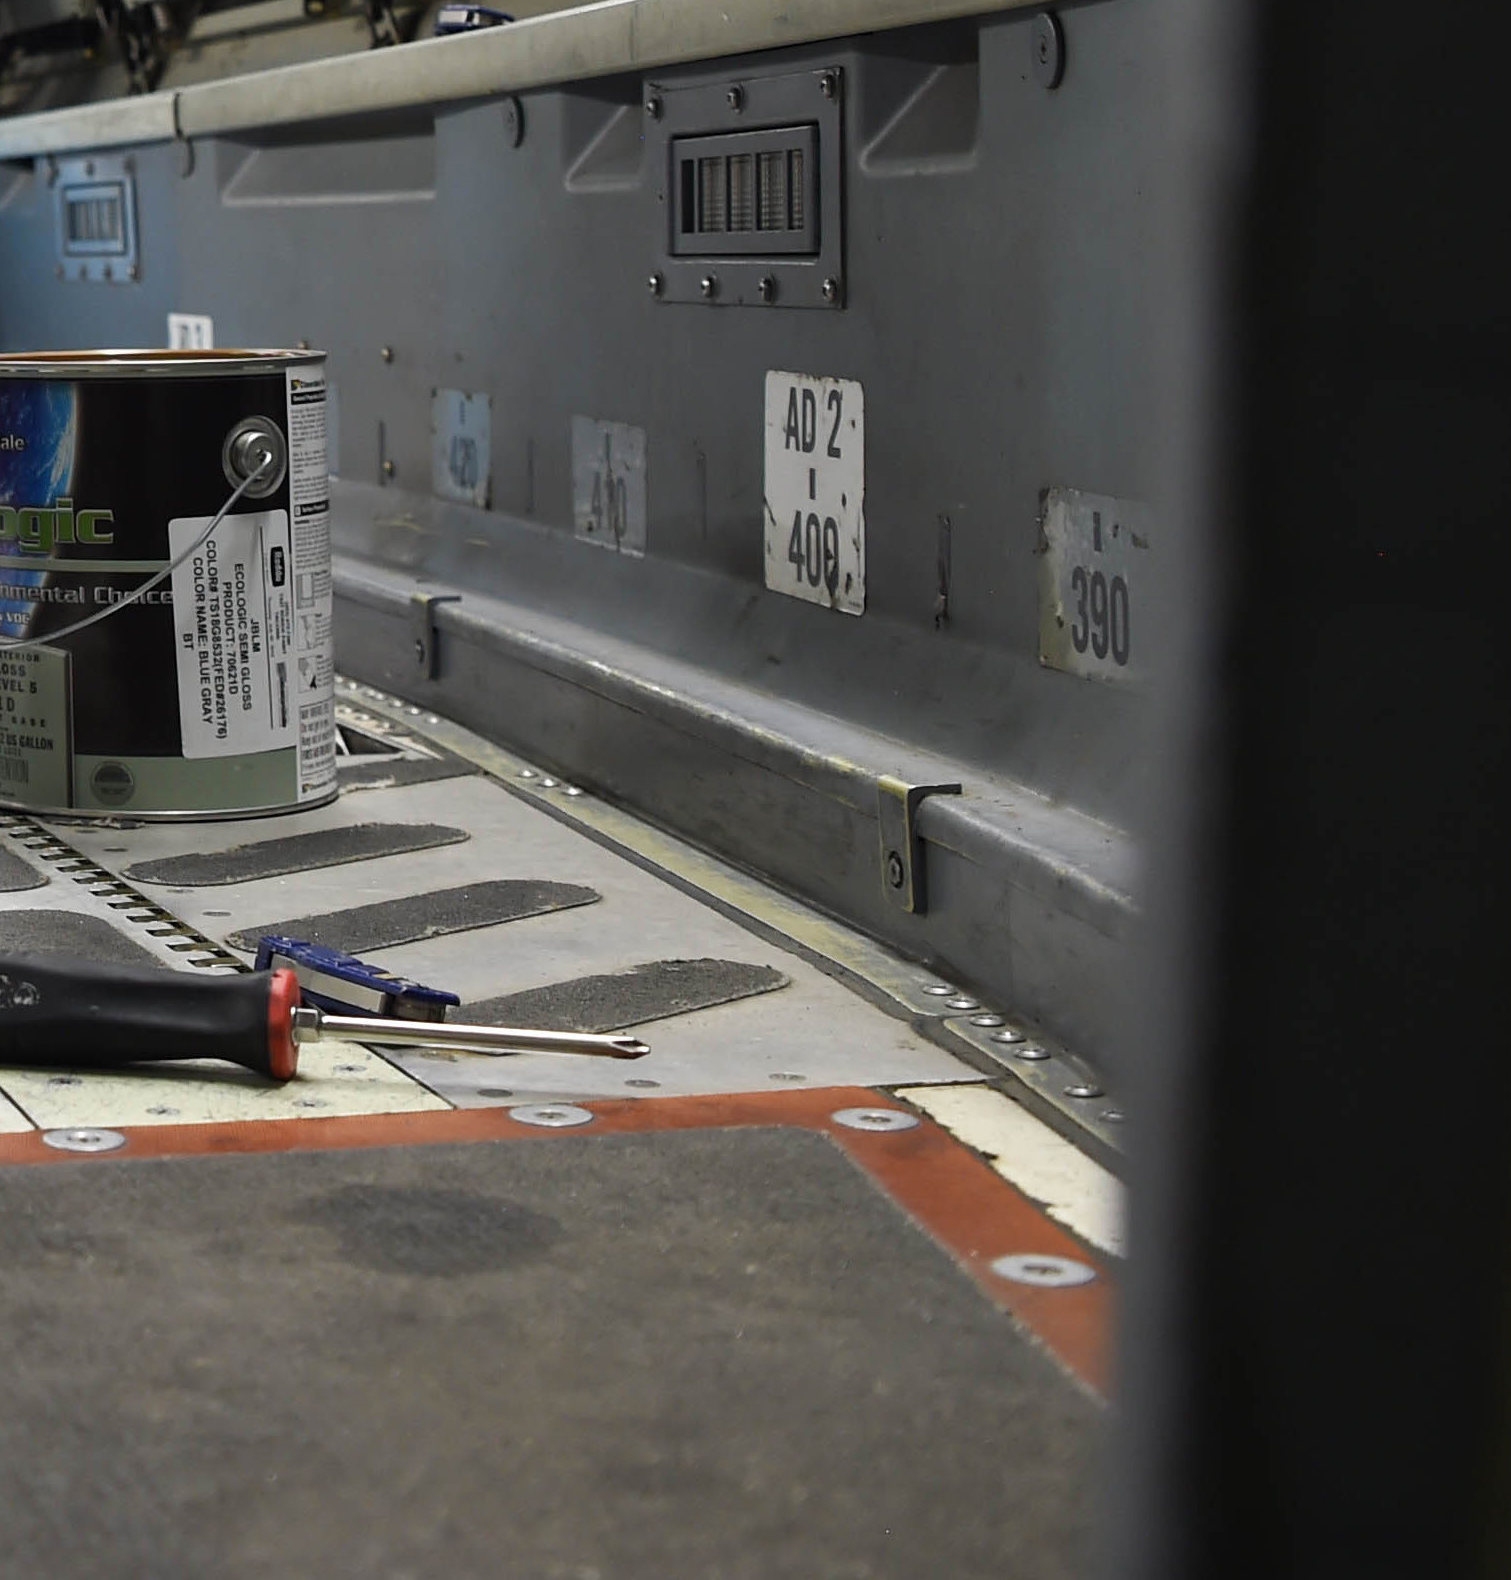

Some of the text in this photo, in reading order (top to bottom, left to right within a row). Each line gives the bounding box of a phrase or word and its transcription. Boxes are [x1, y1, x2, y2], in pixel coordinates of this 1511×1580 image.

[784, 385, 842, 460] AD 2
[205, 539, 219, 593] COLOR#
[787, 509, 840, 596] 400
[182, 632, 194, 651] BT
[192, 556, 214, 725] COLOR NAME: BLUE GRAY
[222, 581, 238, 695] PRODUCT: 70621D
[234, 563, 253, 711] ECOLOGIC SEMI GLOSS
[250, 618, 262, 653] JBLM
[1071, 566, 1131, 667] 390
[7, 697, 15, 713] D
[29, 681, 38, 694] 5
[19, 735, 54, 752] GALLON
